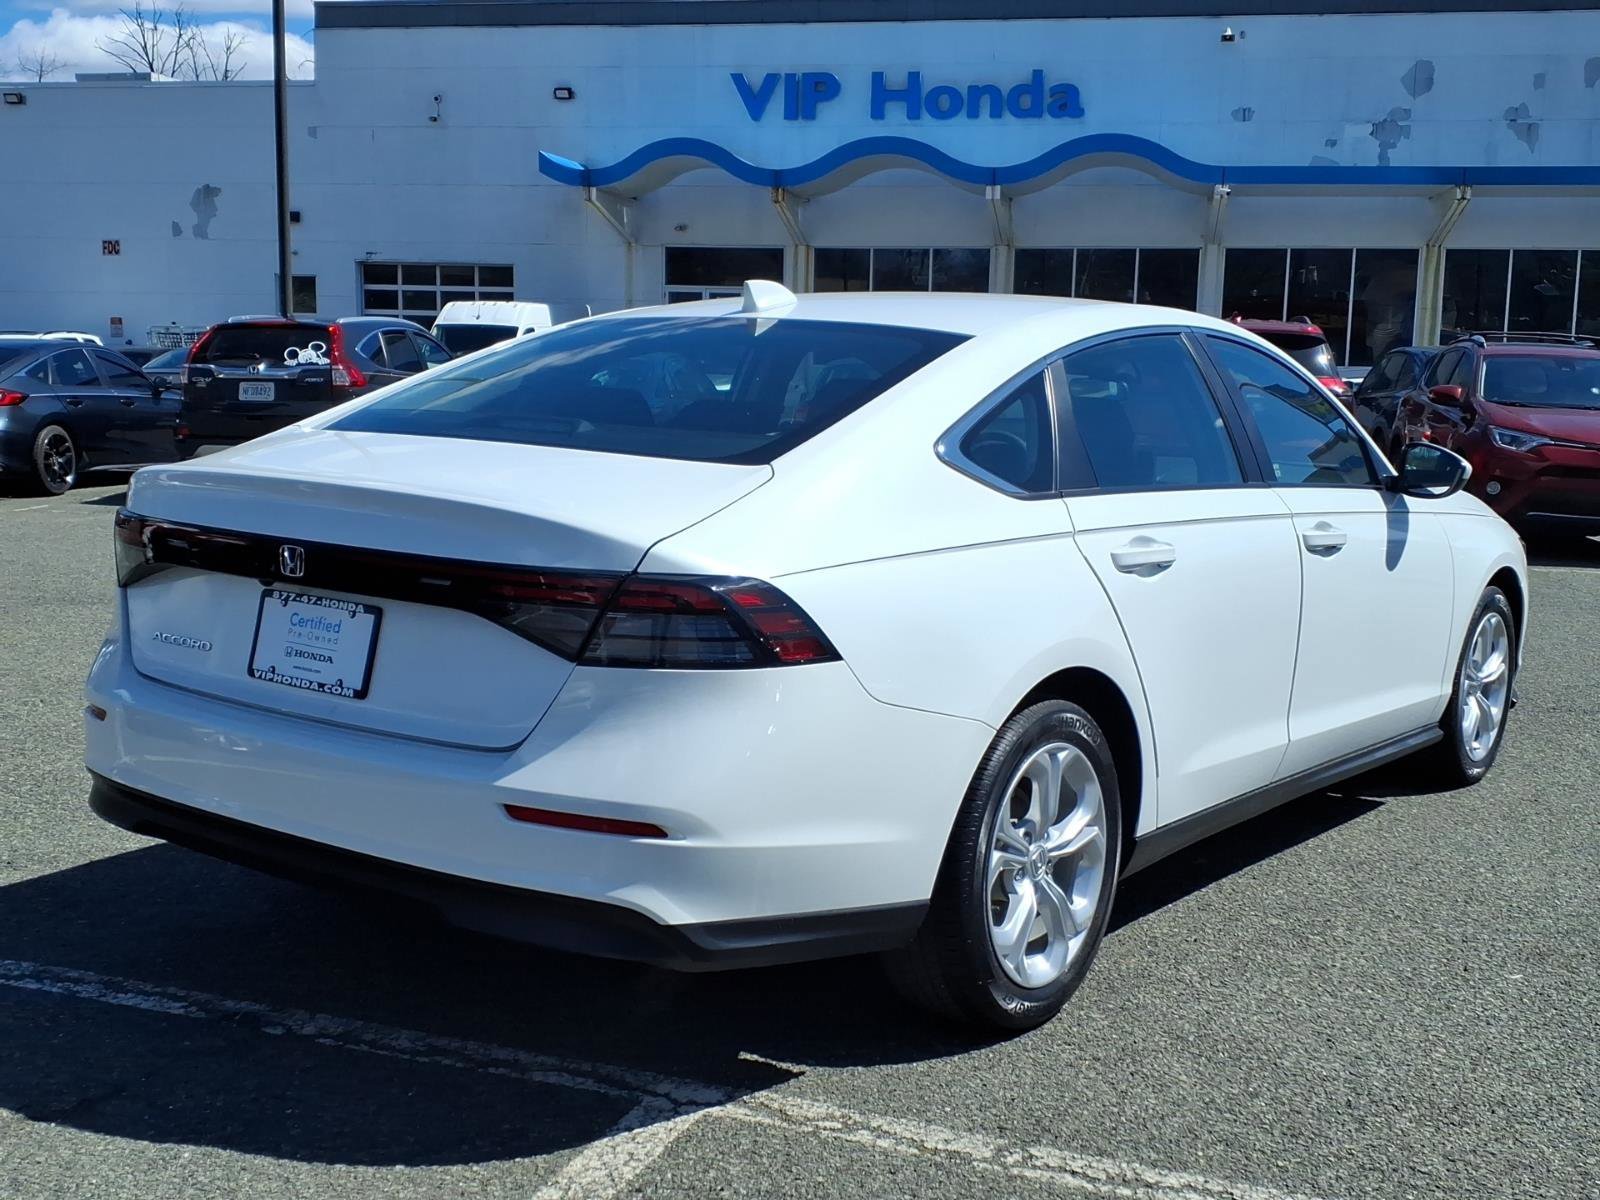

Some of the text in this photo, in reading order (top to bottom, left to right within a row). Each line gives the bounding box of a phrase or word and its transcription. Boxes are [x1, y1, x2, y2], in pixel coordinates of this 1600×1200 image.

[729, 69, 1085, 122] VIP Honda
[102, 240, 120, 255] FDC
[273, 591, 365, 613] 877-47-HONDA
[290, 612, 343, 634] Certified
[153, 632, 212, 651] ACCORD
[288, 628, 340, 645] Pre-Owned
[294, 649, 334, 664] HONDA
[253, 669, 354, 698] VIPHONDA.COM
